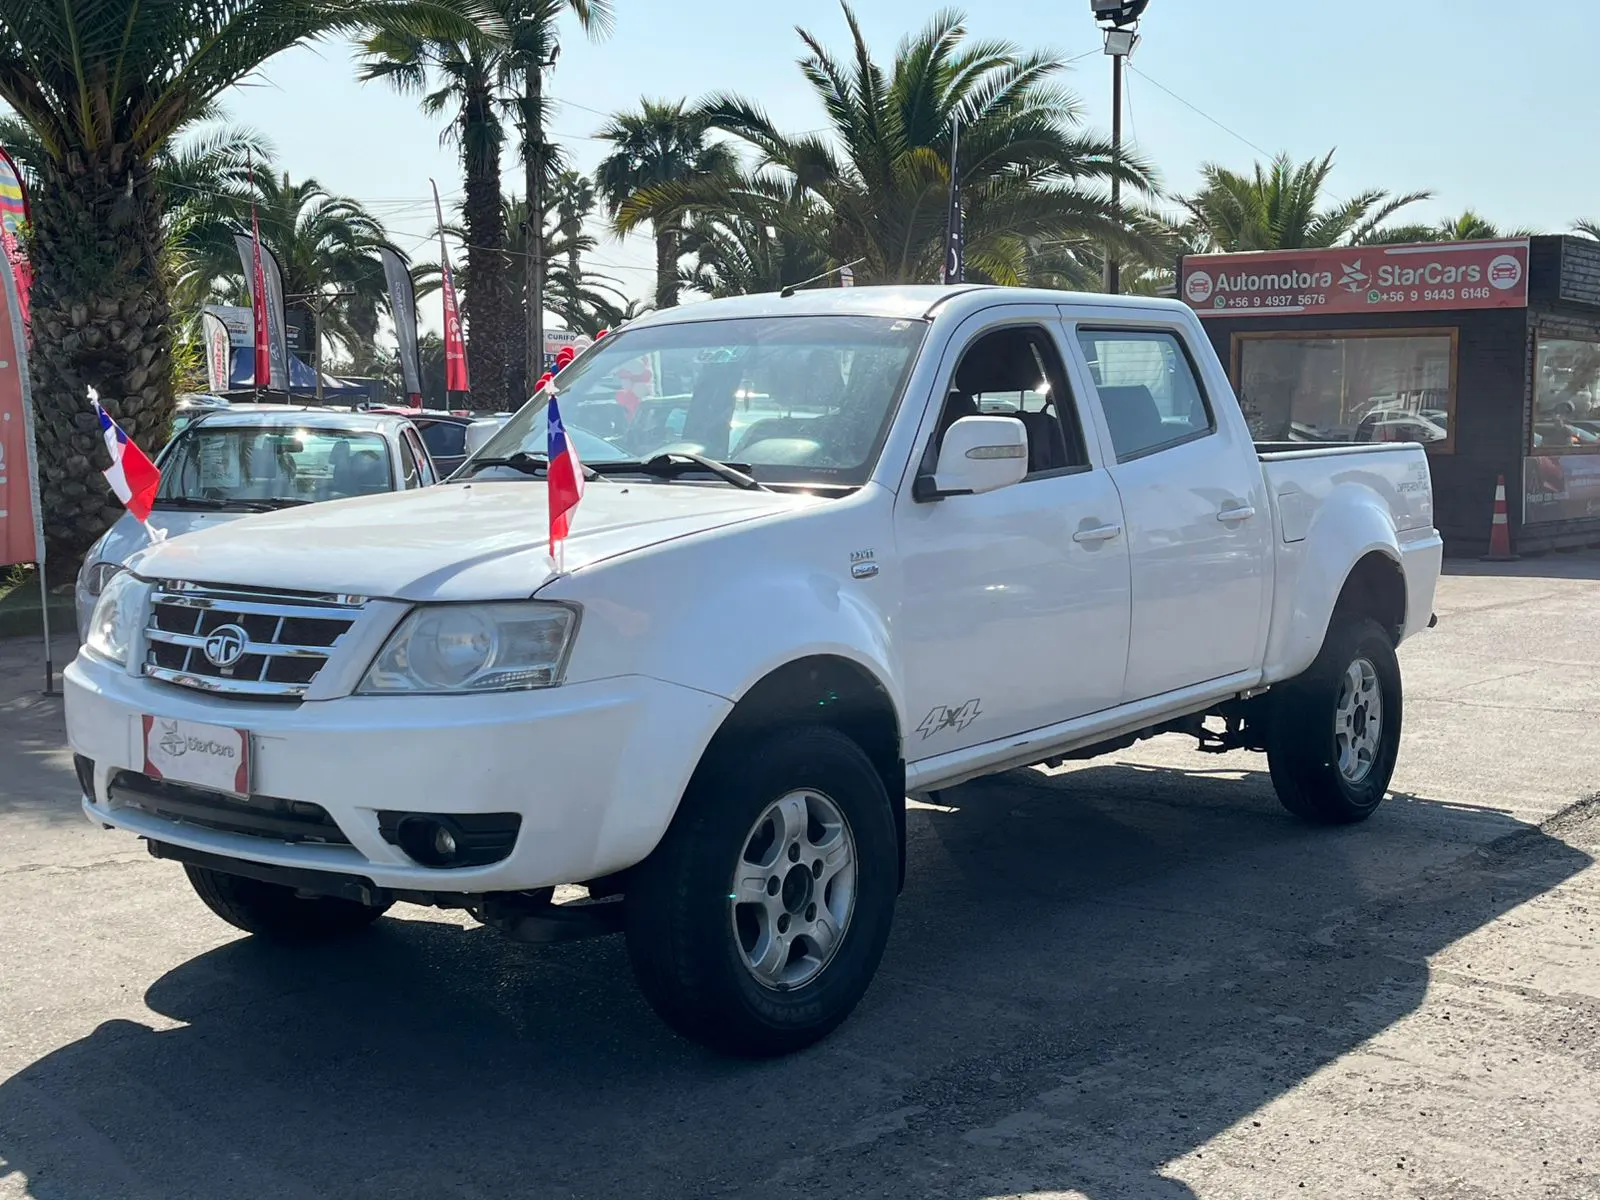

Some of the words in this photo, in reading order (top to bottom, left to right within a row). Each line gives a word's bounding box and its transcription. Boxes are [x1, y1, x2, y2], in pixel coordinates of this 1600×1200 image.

[1215, 271, 1332, 293] Automotora
[1377, 262, 1481, 288] StarCars
[1228, 297, 1249, 307] +56
[1253, 297, 1261, 306] 9
[1265, 295, 1292, 306] 4937
[1297, 294, 1325, 305] 5676
[1381, 291, 1404, 302] +56
[1410, 290, 1418, 301] 9
[1424, 288, 1454, 301] 9443
[1461, 287, 1490, 300] 6146
[188, 737, 235, 758] StarCars
